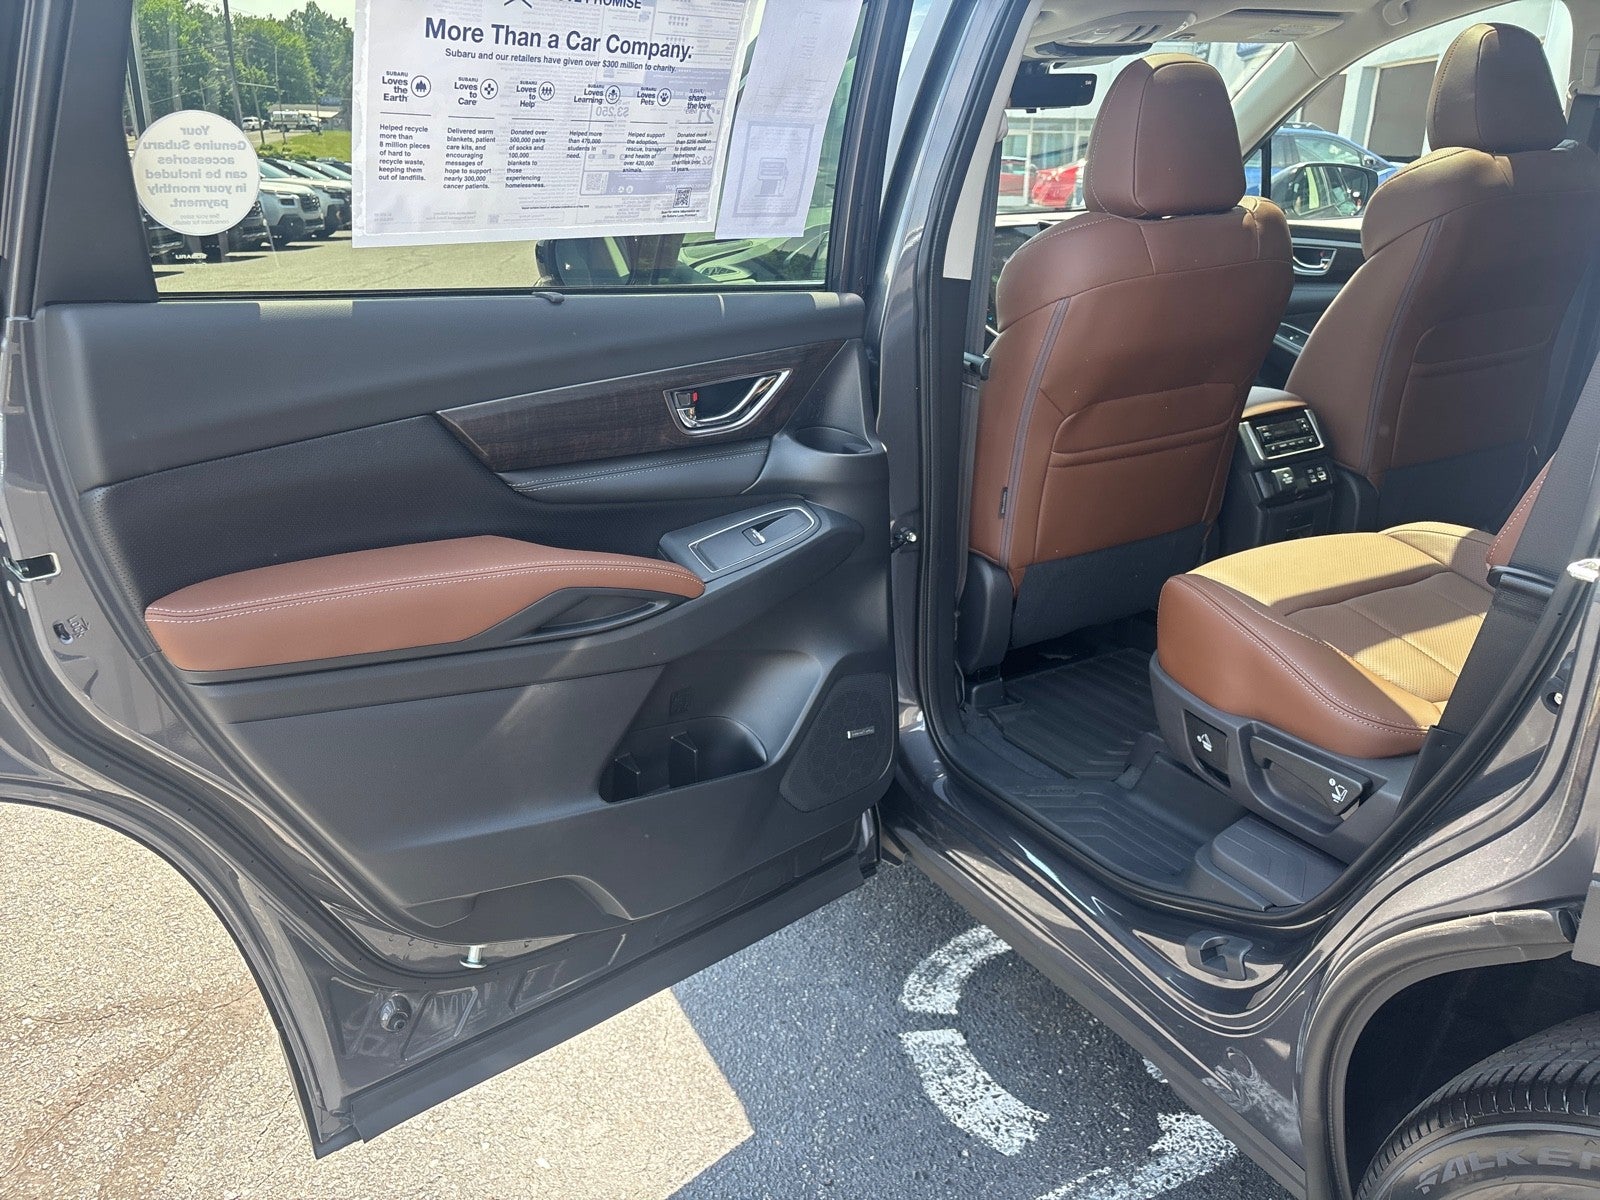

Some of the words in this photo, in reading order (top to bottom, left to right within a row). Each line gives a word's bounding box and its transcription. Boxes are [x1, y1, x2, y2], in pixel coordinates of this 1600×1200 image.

[425, 17, 484, 43] More
[491, 24, 541, 47] Than
[547, 34, 559, 49] a
[566, 30, 601, 51] Car
[606, 34, 692, 62] Company.
[445, 48, 476, 59] Subaru
[478, 52, 494, 60] and
[495, 53, 509, 61] our
[511, 54, 541, 63] retailers
[543, 56, 561, 64] have
[563, 57, 583, 66] given
[585, 58, 600, 66] over
[602, 60, 618, 69] $300
[620, 61, 643, 70] million
[653, 64, 676, 73] charity.
[382, 76, 408, 86] Loves
[394, 85, 408, 94] the
[454, 82, 478, 90] Loves
[516, 85, 537, 93] Loves
[469, 91, 478, 99] to
[583, 88, 604, 96] Loves
[636, 91, 656, 99] Loves
[383, 93, 408, 102] Earth
[573, 95, 604, 105] Learning
[687, 94, 707, 102] share
[457, 98, 477, 106] Care
[519, 100, 537, 109] Help
[640, 98, 656, 106] Pets
[687, 101, 698, 110] the
[698, 101, 712, 110] love
[379, 124, 403, 132] Helped
[404, 125, 429, 134] recycle
[447, 127, 477, 135] Delivered
[446, 136, 475, 144] blankets,
[475, 136, 496, 144] patient
[385, 141, 408, 149] million
[409, 142, 431, 150] pieces
[446, 152, 484, 160] encouraging
[379, 158, 403, 166] recycle
[378, 166, 405, 174] keeping
[444, 175, 463, 183] nearly
